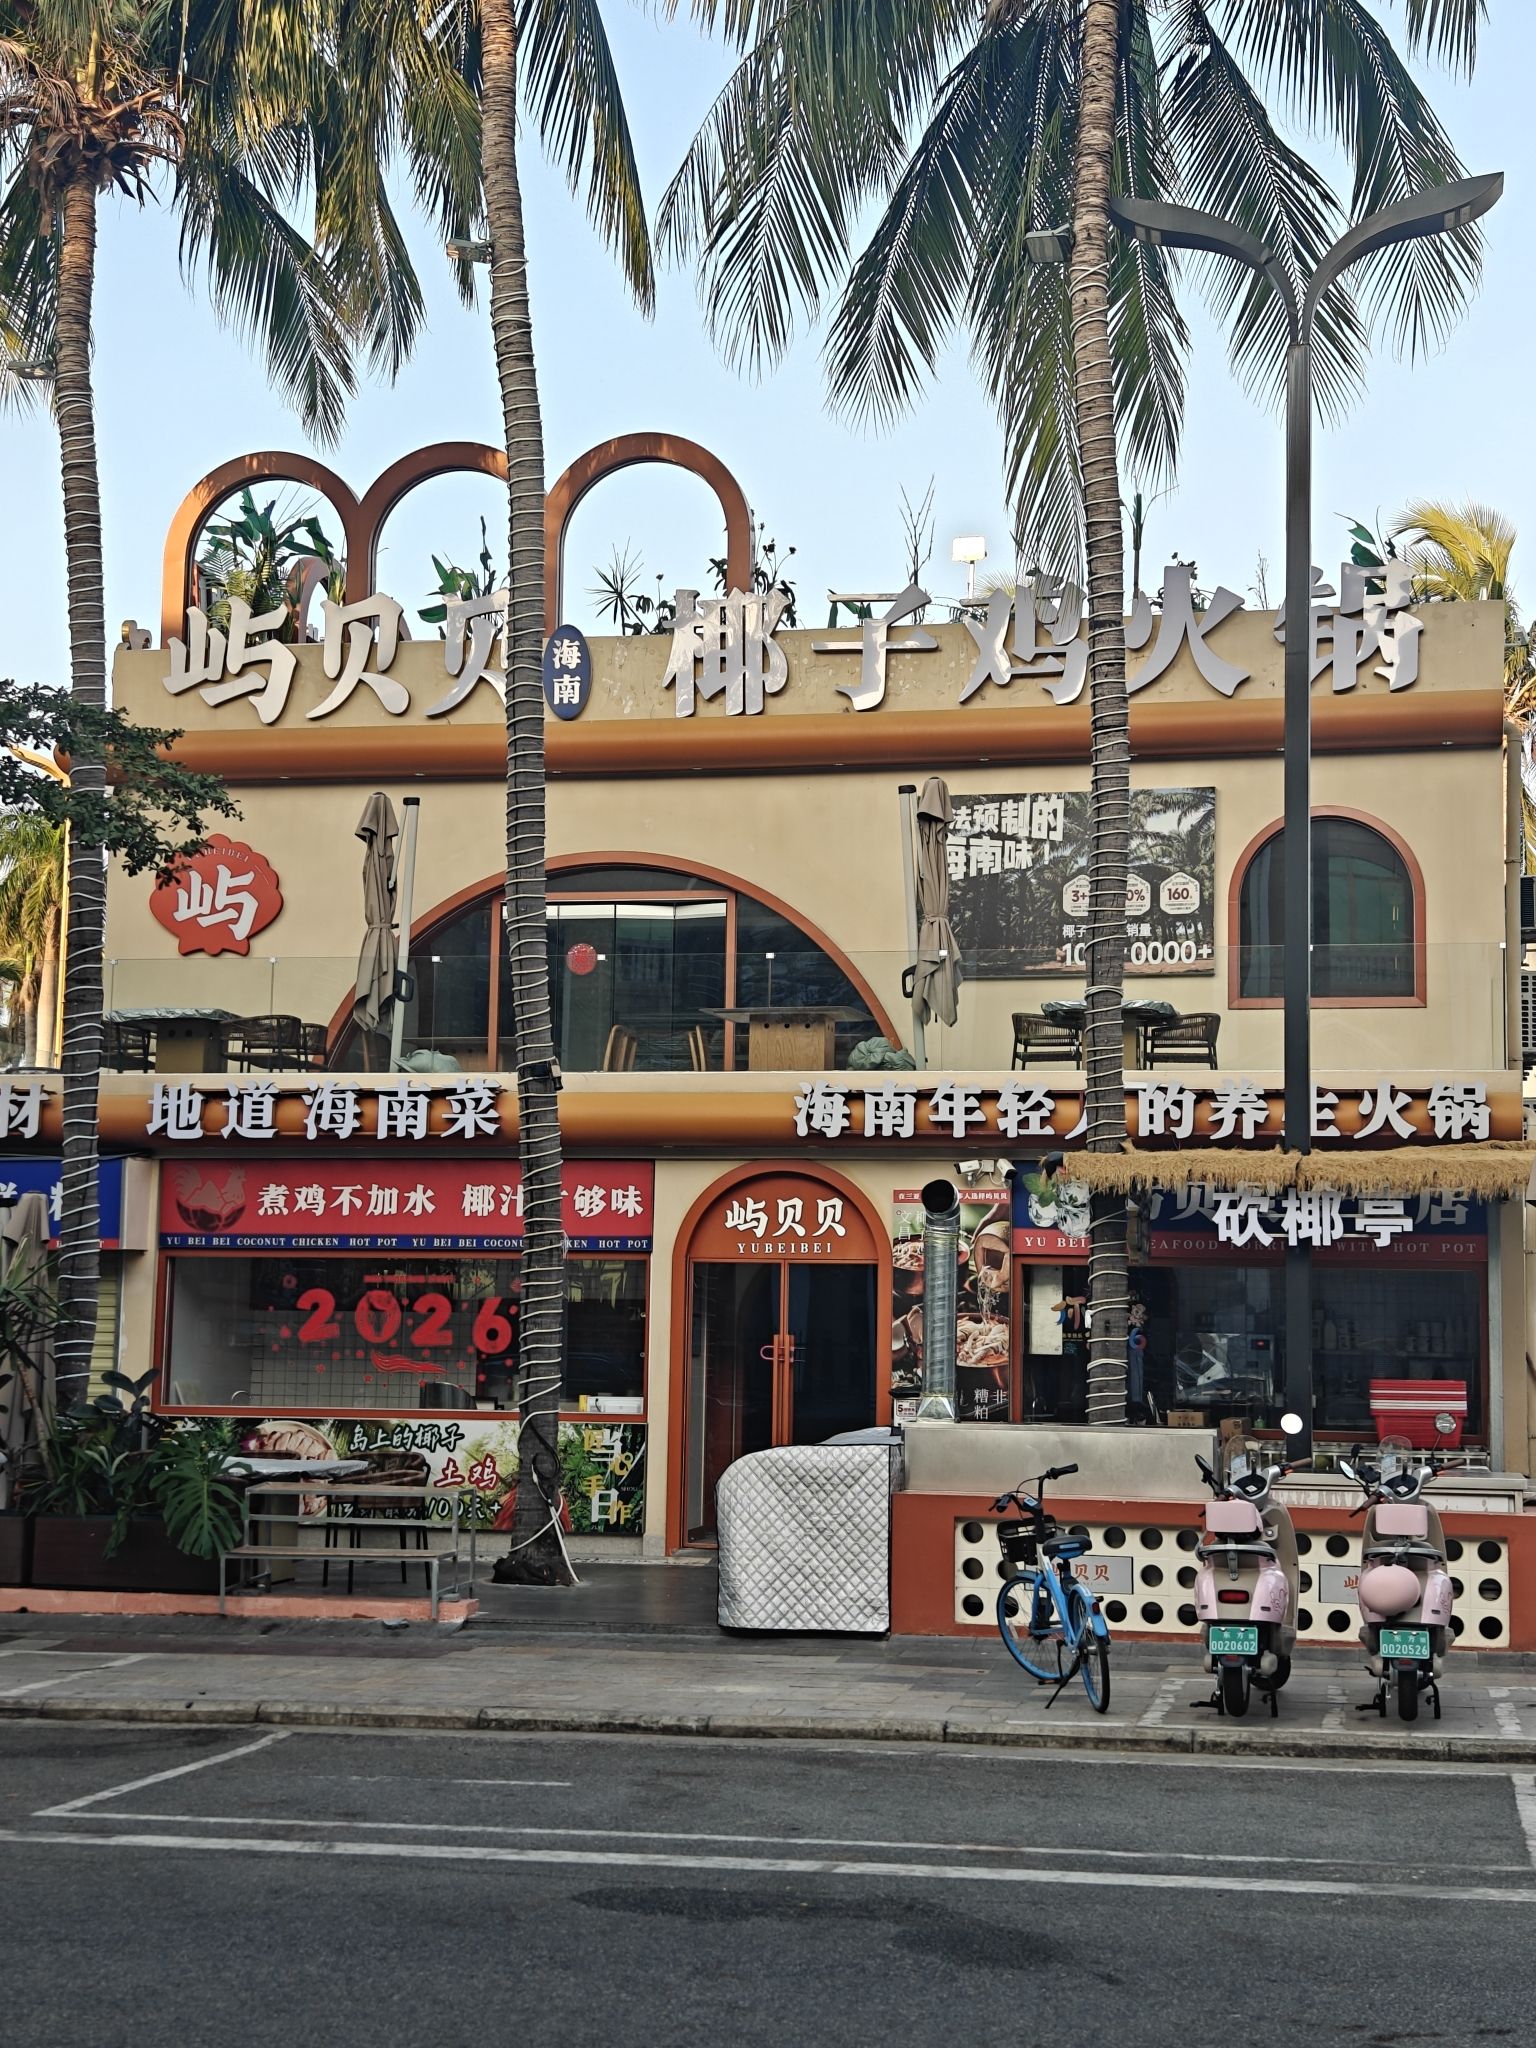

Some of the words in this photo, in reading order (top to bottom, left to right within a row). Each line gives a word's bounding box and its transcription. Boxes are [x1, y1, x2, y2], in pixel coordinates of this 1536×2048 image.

[662, 558, 1424, 717] 椰子鸡火锅
[552, 638, 581, 705] 海南
[173, 864, 259, 941] 屿
[1127, 889, 1145, 901] 0%
[1167, 887, 1190, 901] 160
[146, 1079, 502, 1140] 地道海南菜
[257, 1183, 436, 1217] 煮鸡不加水
[461, 1183, 644, 1218] 椰汁够味
[724, 1196, 847, 1239] 屿贝贝
[1211, 1186, 1414, 1248] 砍椰亭
[166, 1237, 181, 1245] YU
[188, 1237, 206, 1246] BEI
[212, 1237, 231, 1246] BEI
[237, 1237, 286, 1246] COCONUT
[292, 1237, 339, 1247] CHICKEN
[349, 1237, 371, 1247] HOT
[377, 1237, 397, 1247] POT
[412, 1238, 426, 1247] YU
[433, 1238, 452, 1247] BEI
[458, 1238, 477, 1248] BEI
[483, 1238, 524, 1248] COCONU
[599, 1239, 620, 1249] HOT
[627, 1239, 648, 1249] POT
[737, 1242, 833, 1254] YUBEIBEI
[1024, 1237, 1046, 1247] YU
[1057, 1238, 1086, 1248] BEI
[1149, 1239, 1218, 1250] EAFOOD
[1393, 1242, 1430, 1253] HOT
[1441, 1243, 1477, 1254] POT
[297, 1288, 513, 1354] 2026
[350, 1423, 465, 1452] 岛上的椰子
[434, 1454, 499, 1489] 土鸡
[1211, 1641, 1256, 1651] 0020602
[1382, 1643, 1428, 1656] 0020526
